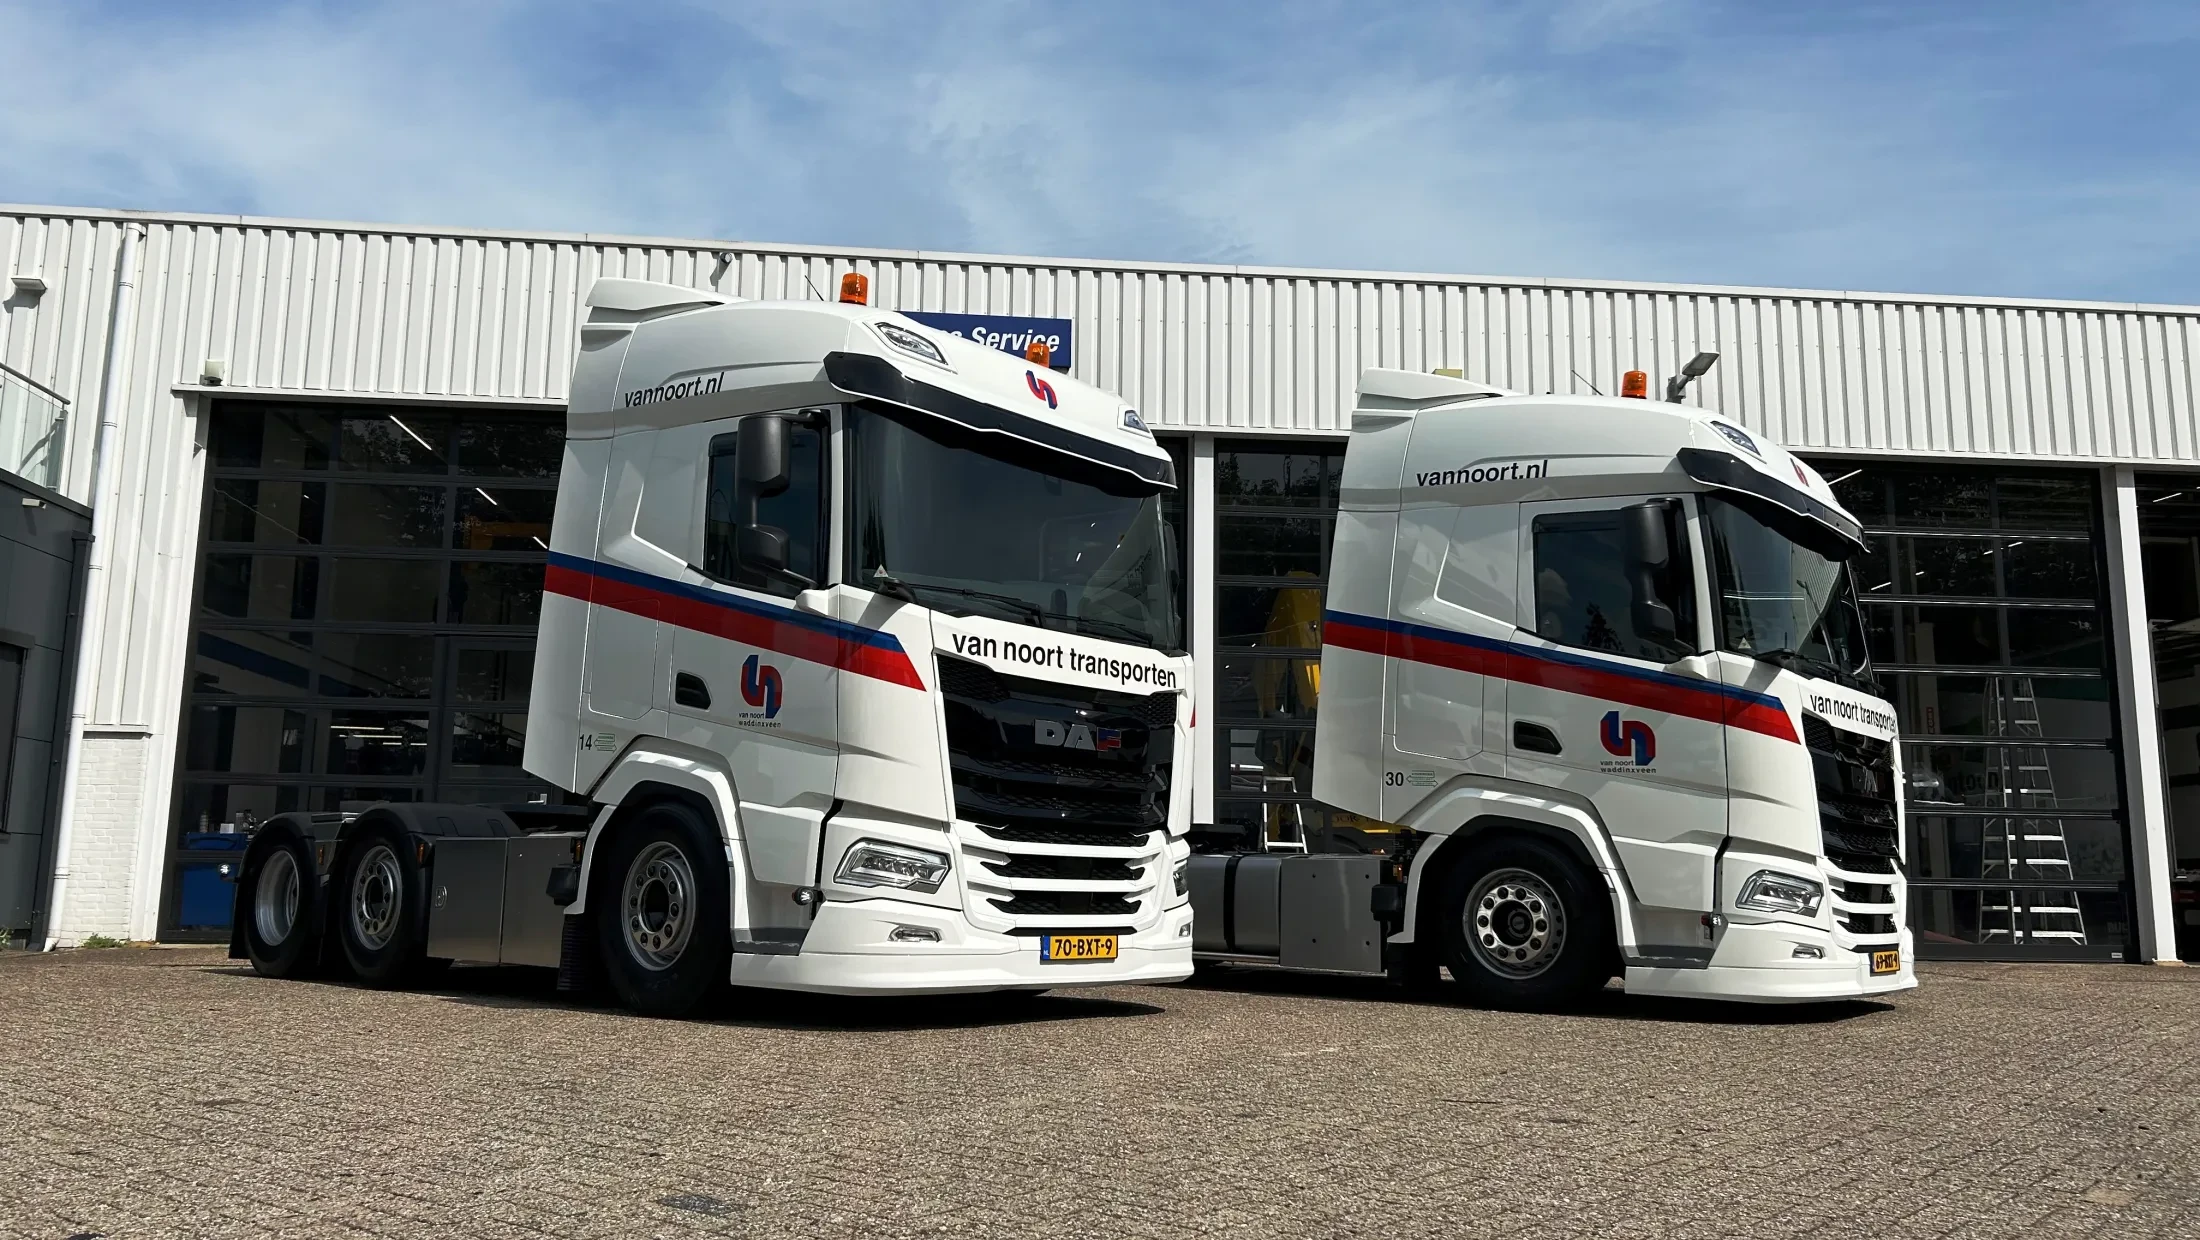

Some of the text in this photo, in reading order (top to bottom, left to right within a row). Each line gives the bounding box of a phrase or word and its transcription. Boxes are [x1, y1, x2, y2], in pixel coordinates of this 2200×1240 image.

[971, 326, 1060, 353] Service
[624, 372, 725, 409] vannoort.nl
[1416, 459, 1548, 487] vannoort.nl
[952, 633, 1177, 688] van noort transporten
[1809, 694, 1832, 714] van
[1833, 699, 1859, 721] noort
[738, 720, 782, 728] waddinxveen
[1034, 718, 1122, 752] DAF
[579, 733, 593, 751] 14
[1385, 771, 1404, 787] 30
[1055, 938, 1113, 957] 70-BXT-9
